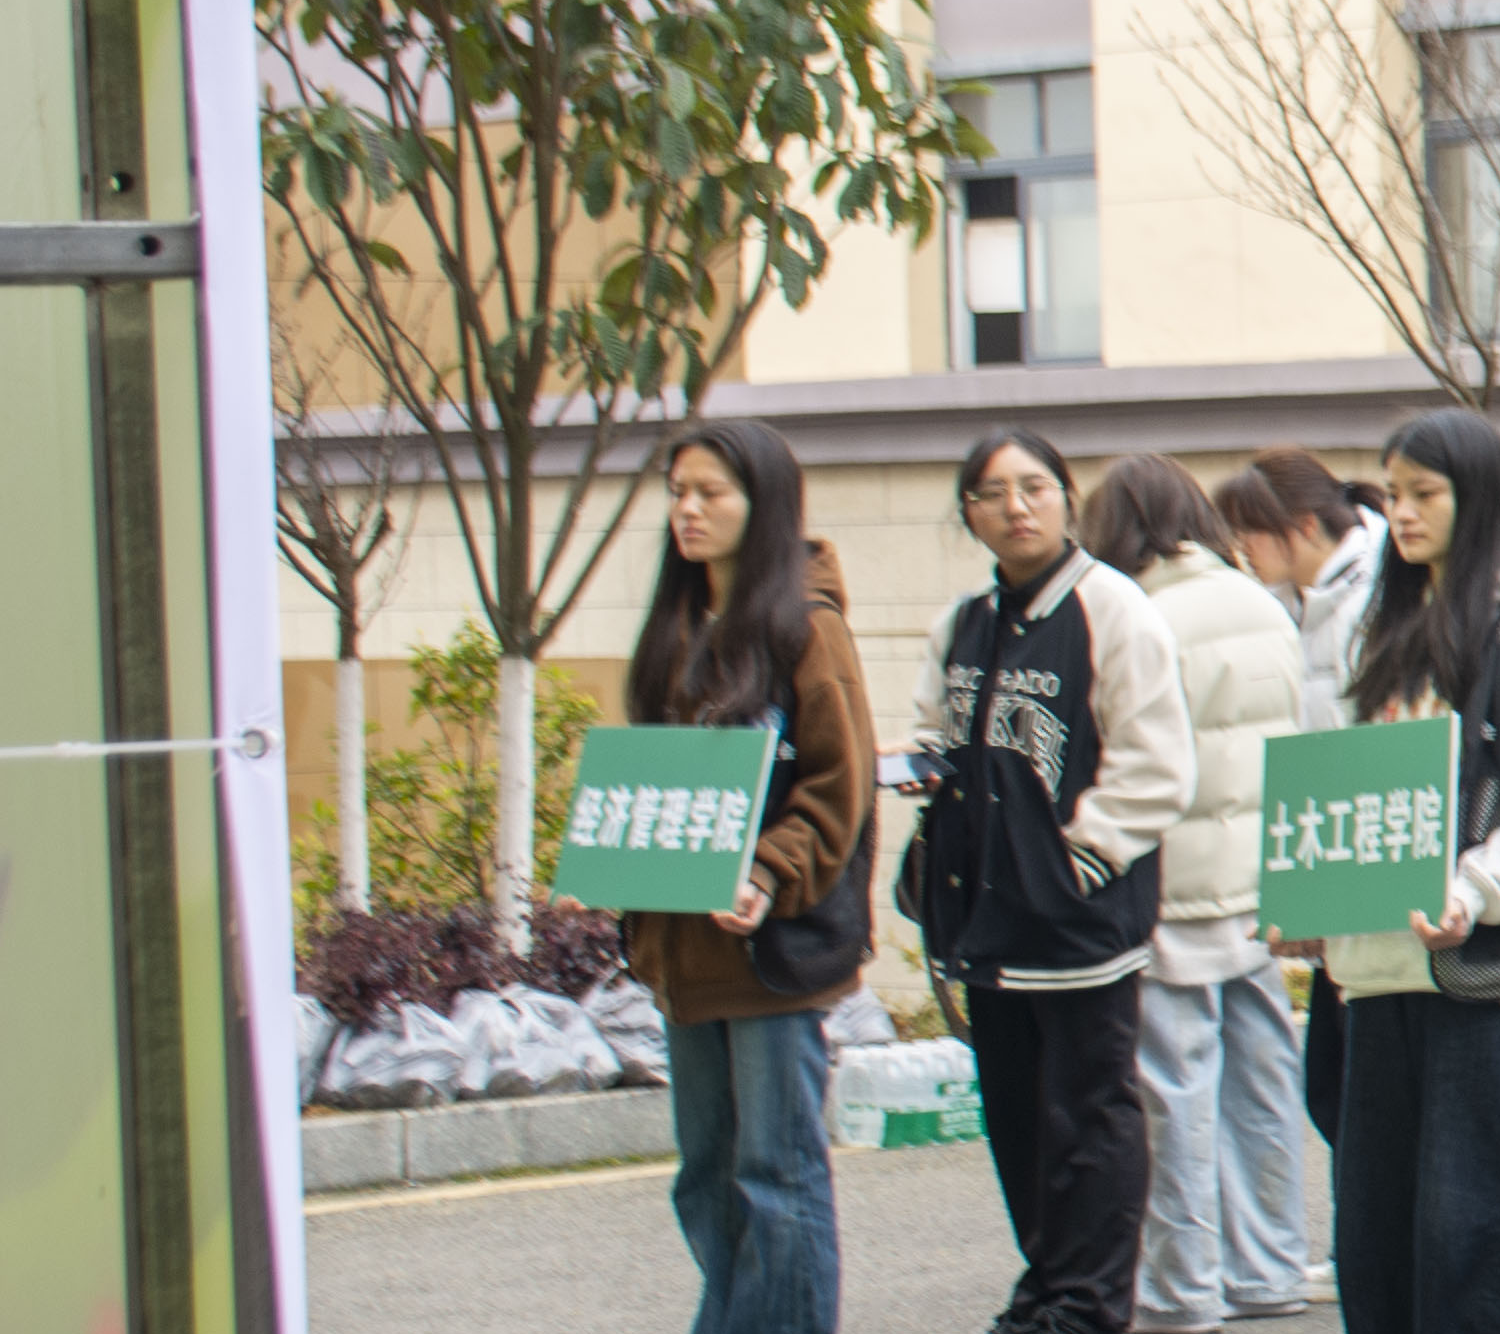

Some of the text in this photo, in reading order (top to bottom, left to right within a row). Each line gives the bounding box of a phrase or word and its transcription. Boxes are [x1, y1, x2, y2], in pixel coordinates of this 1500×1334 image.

[568, 783, 752, 853] 经济管理学院
[1265, 783, 1443, 872] 土木工程学院
